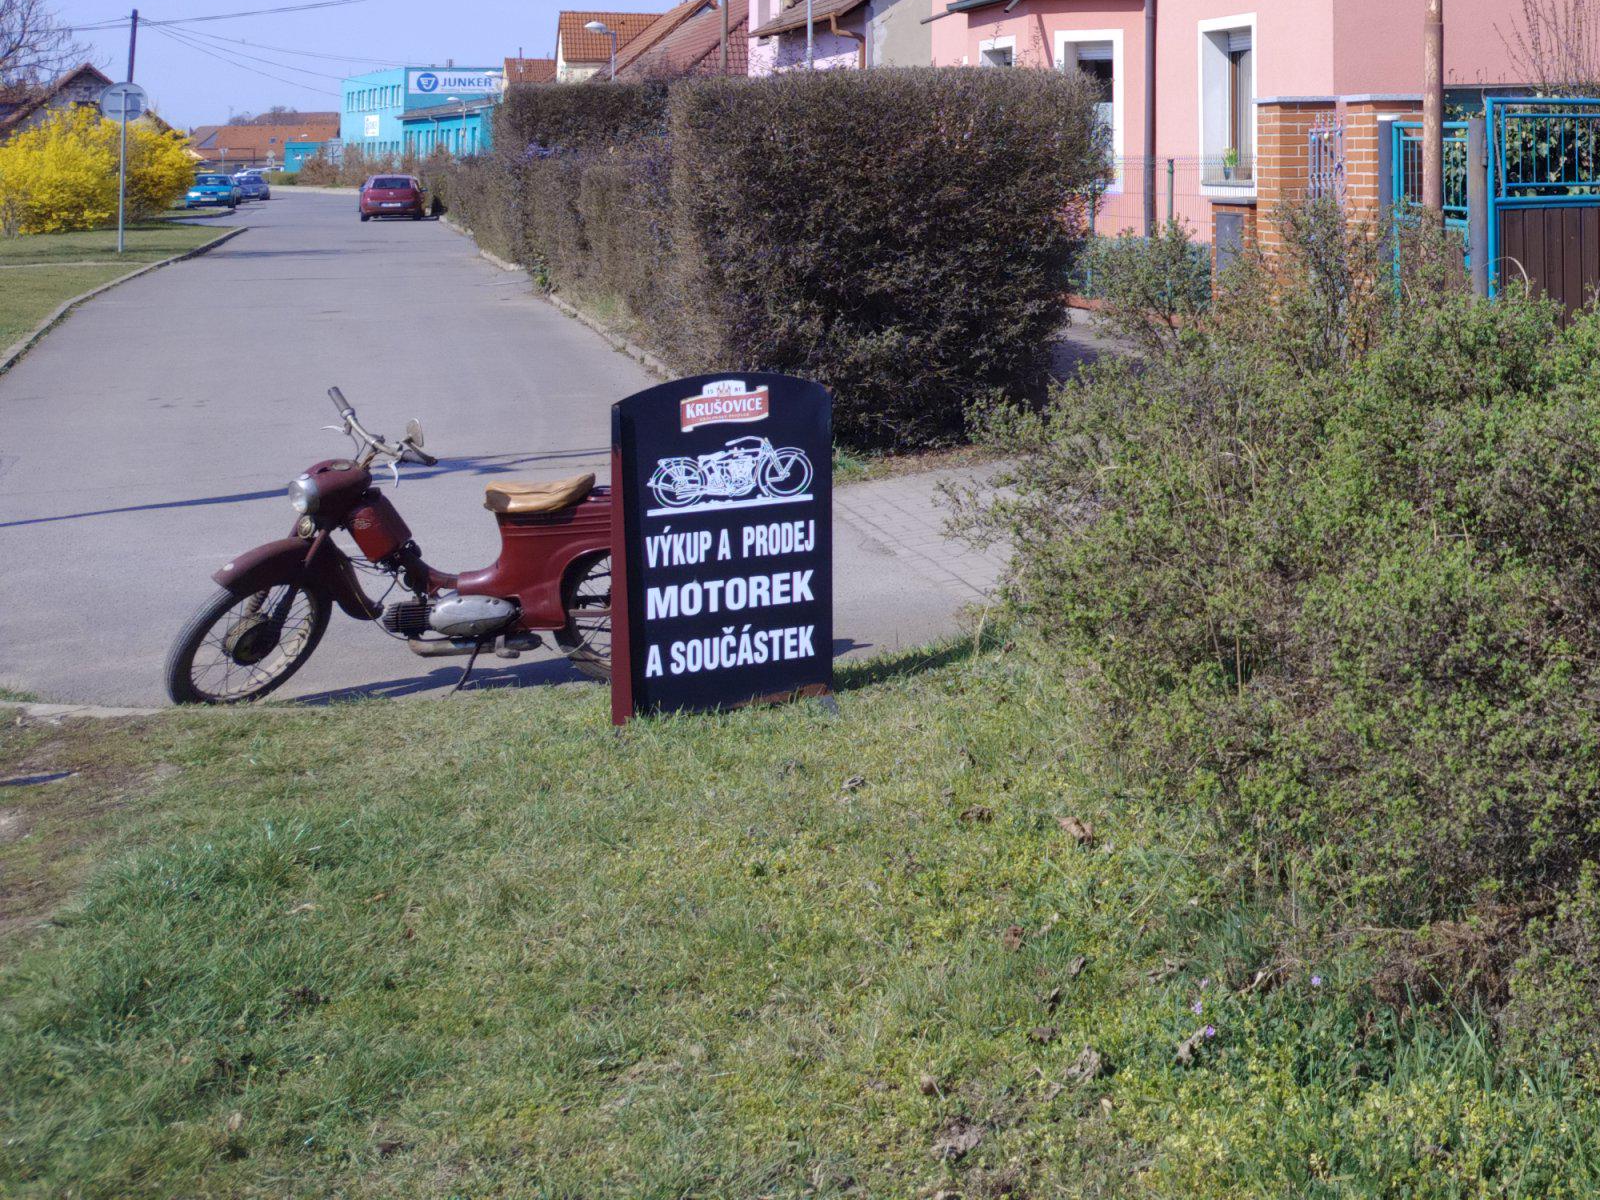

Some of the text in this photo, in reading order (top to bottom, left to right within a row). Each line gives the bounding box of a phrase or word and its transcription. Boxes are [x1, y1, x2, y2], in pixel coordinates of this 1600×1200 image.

[441, 77, 492, 87] JUNKER
[685, 397, 763, 419] KRUŠOVICE
[645, 520, 815, 568] VÝKUP A PRODEJ
[647, 569, 815, 620] MOTOREK
[645, 624, 815, 678] A SOUČÁSTEK
